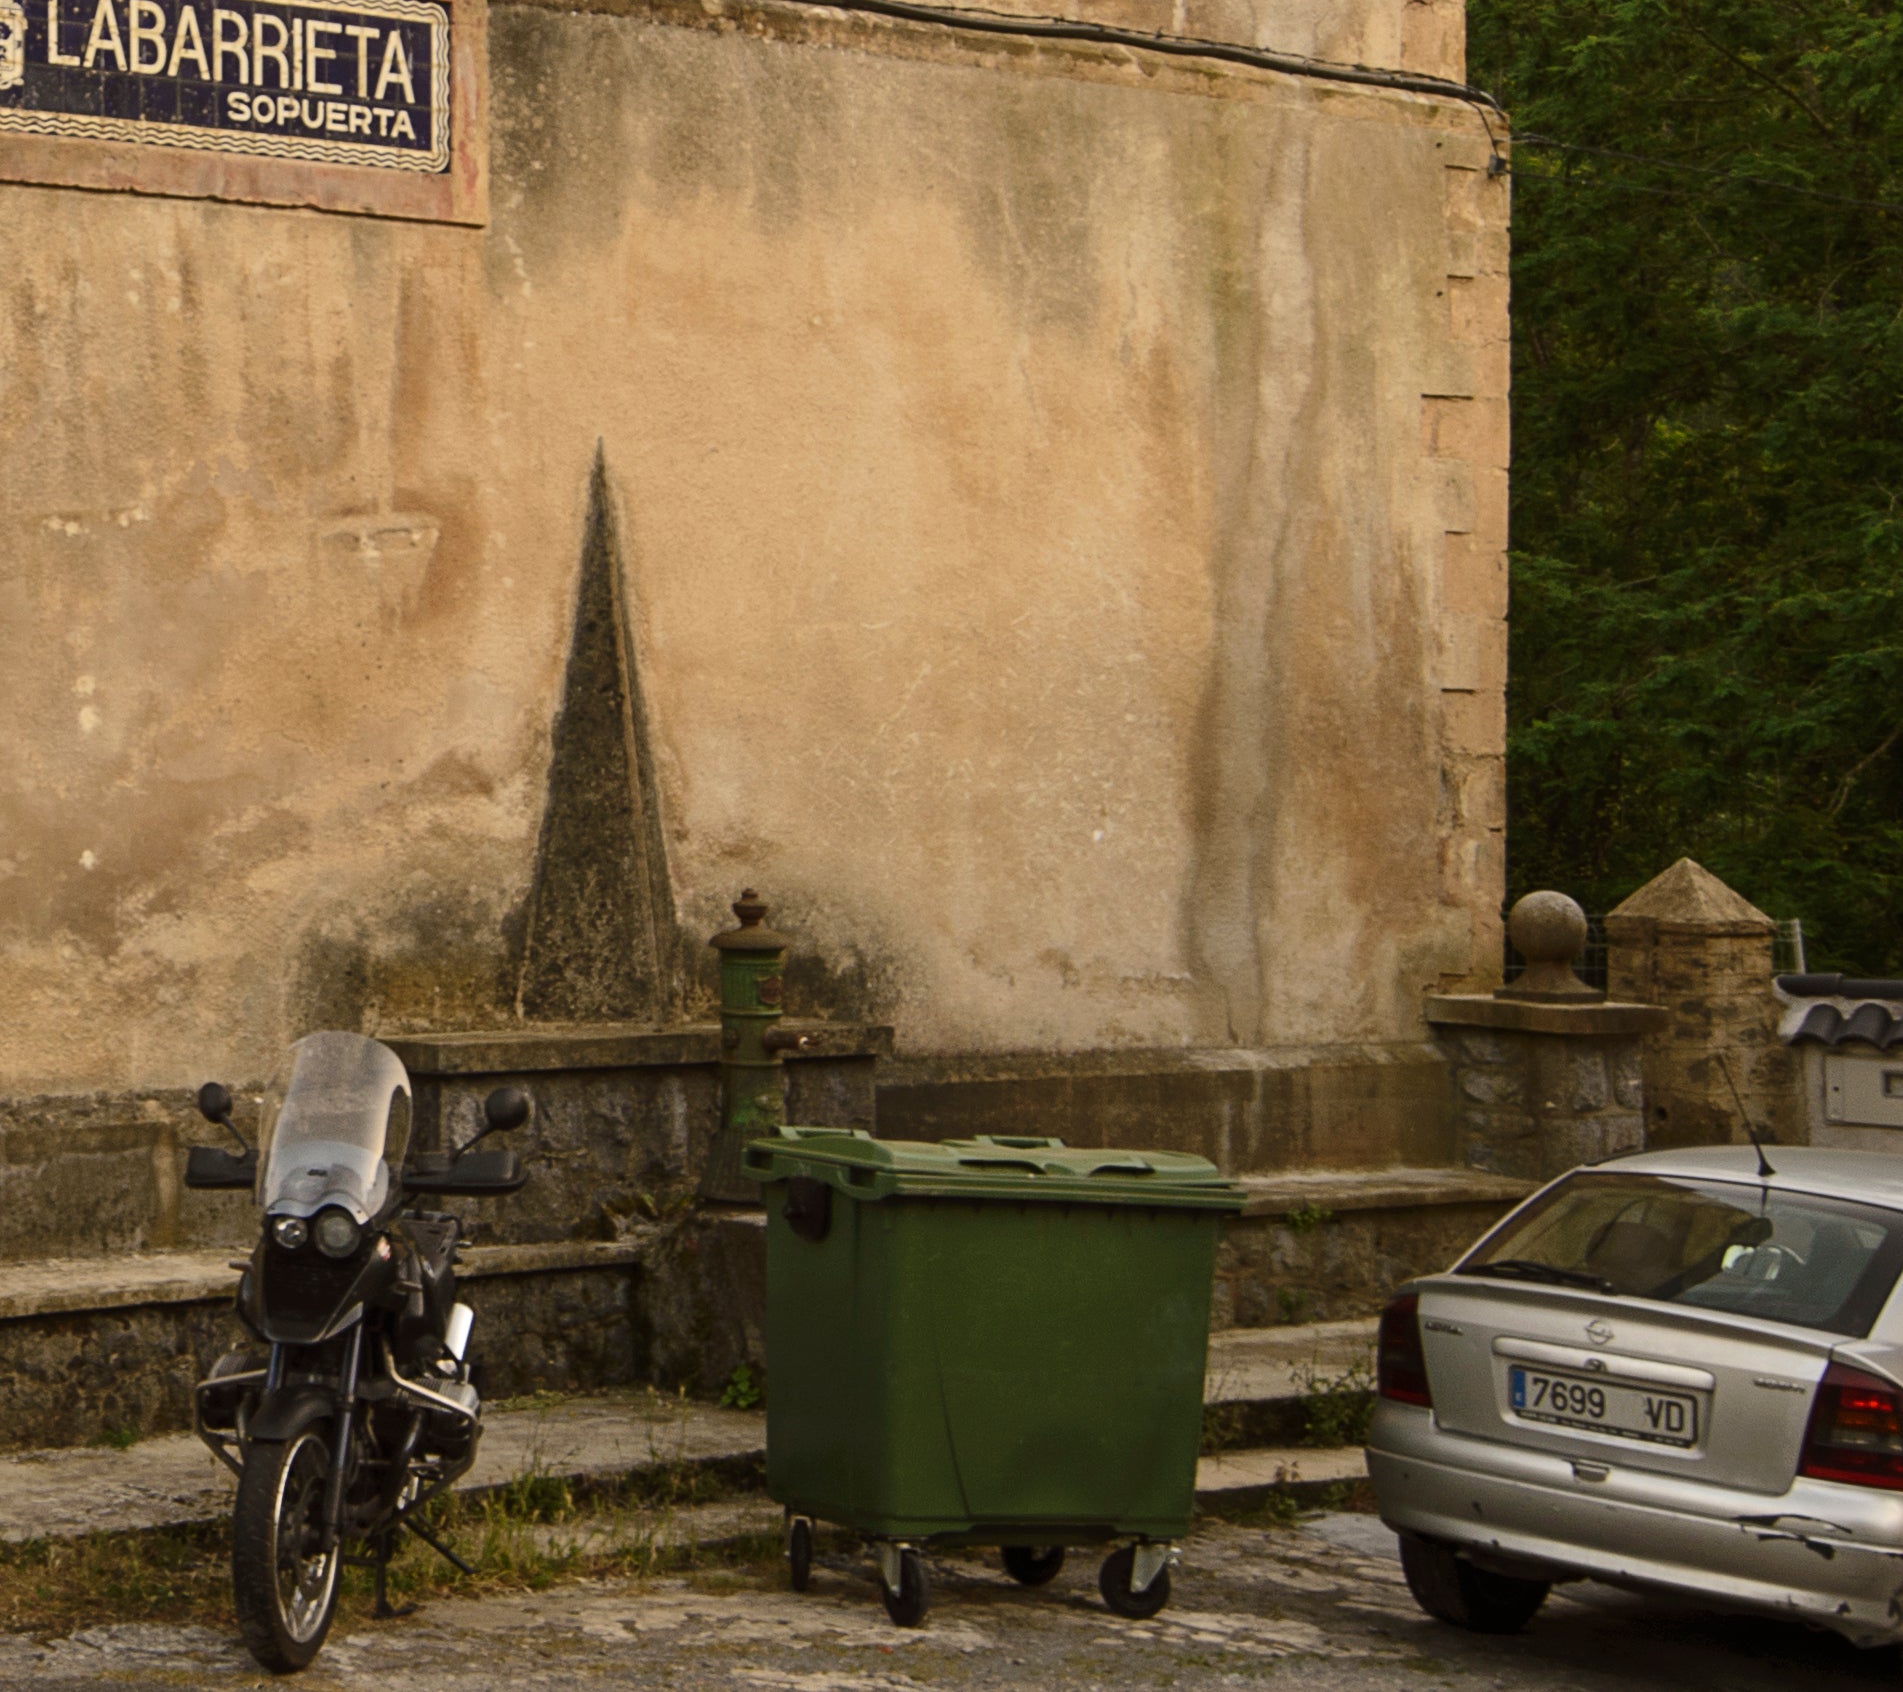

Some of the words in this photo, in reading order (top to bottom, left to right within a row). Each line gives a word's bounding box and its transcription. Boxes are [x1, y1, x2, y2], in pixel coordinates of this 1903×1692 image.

[226, 92, 416, 140] SOPUERTA
[1532, 1377, 1606, 1419] 7699
[1645, 1396, 1685, 1433] VD
